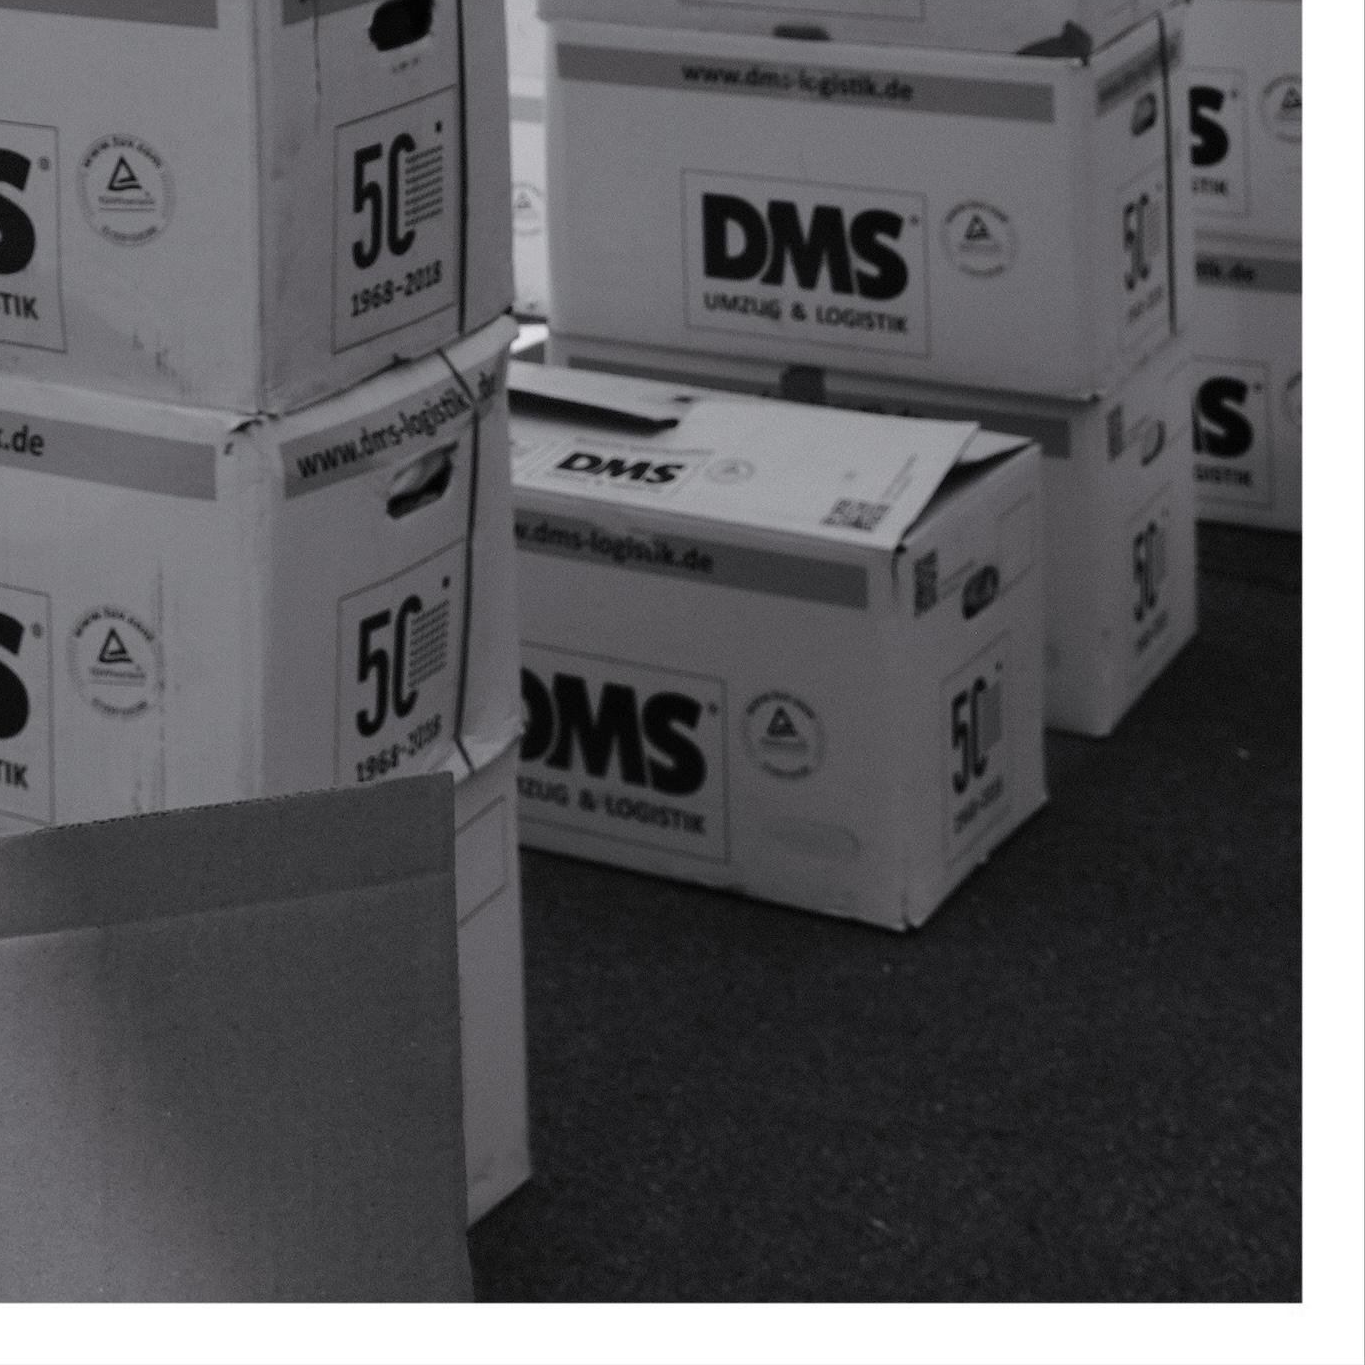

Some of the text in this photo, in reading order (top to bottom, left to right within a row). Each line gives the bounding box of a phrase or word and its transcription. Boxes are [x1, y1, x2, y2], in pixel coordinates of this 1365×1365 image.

[701, 191, 909, 302] DMS
[349, 260, 443, 317] 1968-2018
[705, 292, 907, 334] UMZUG & LOGISTIK
[557, 452, 684, 485] DMS
